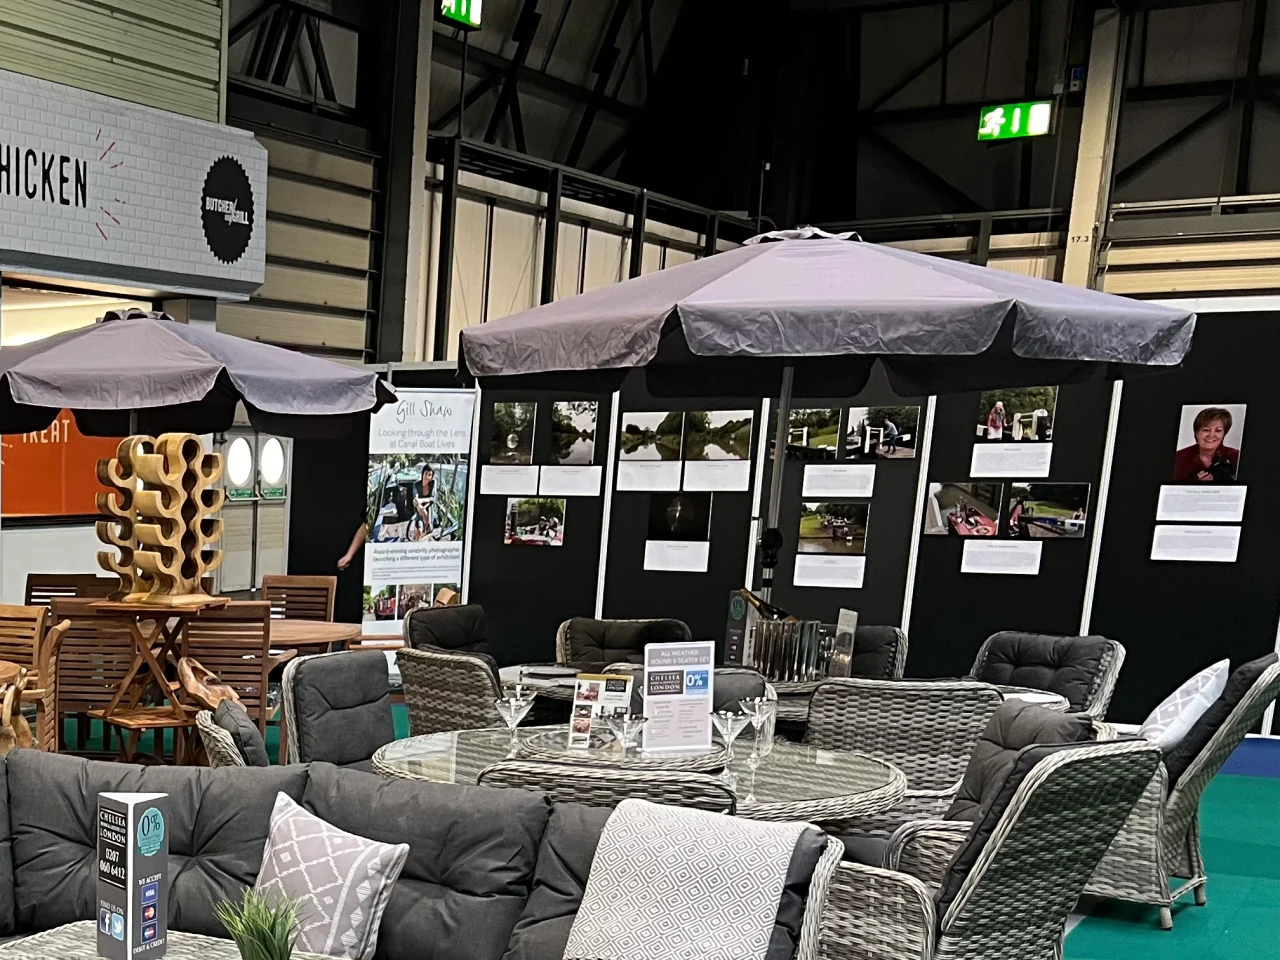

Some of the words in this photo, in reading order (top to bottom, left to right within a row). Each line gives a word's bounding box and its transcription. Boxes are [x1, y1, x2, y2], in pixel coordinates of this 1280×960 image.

[205, 197, 234, 214] BUTCHER
[396, 399, 415, 424] Gill
[420, 400, 452, 417] Shaw
[378, 428, 406, 438] Looking
[407, 428, 435, 438] through
[436, 429, 448, 437] the
[450, 429, 466, 437] Lens
[398, 440, 417, 448] Canal
[420, 440, 435, 448] Boat
[437, 440, 455, 448] Lives
[686, 674, 702, 686] 0%
[100, 811, 126, 827] CHELSEA
[141, 813, 161, 837] 0%
[100, 828, 126, 844] LONDON
[105, 847, 119, 862] 0207
[100, 859, 110, 874] 060
[111, 864, 125, 879] 6412
[138, 877, 145, 886] WE
[146, 873, 162, 884] ACCEPT
[100, 900, 110, 910] FIND
[111, 904, 116, 913] US
[133, 945, 146, 955] DEBIT
[150, 938, 166, 948] CREDIT
